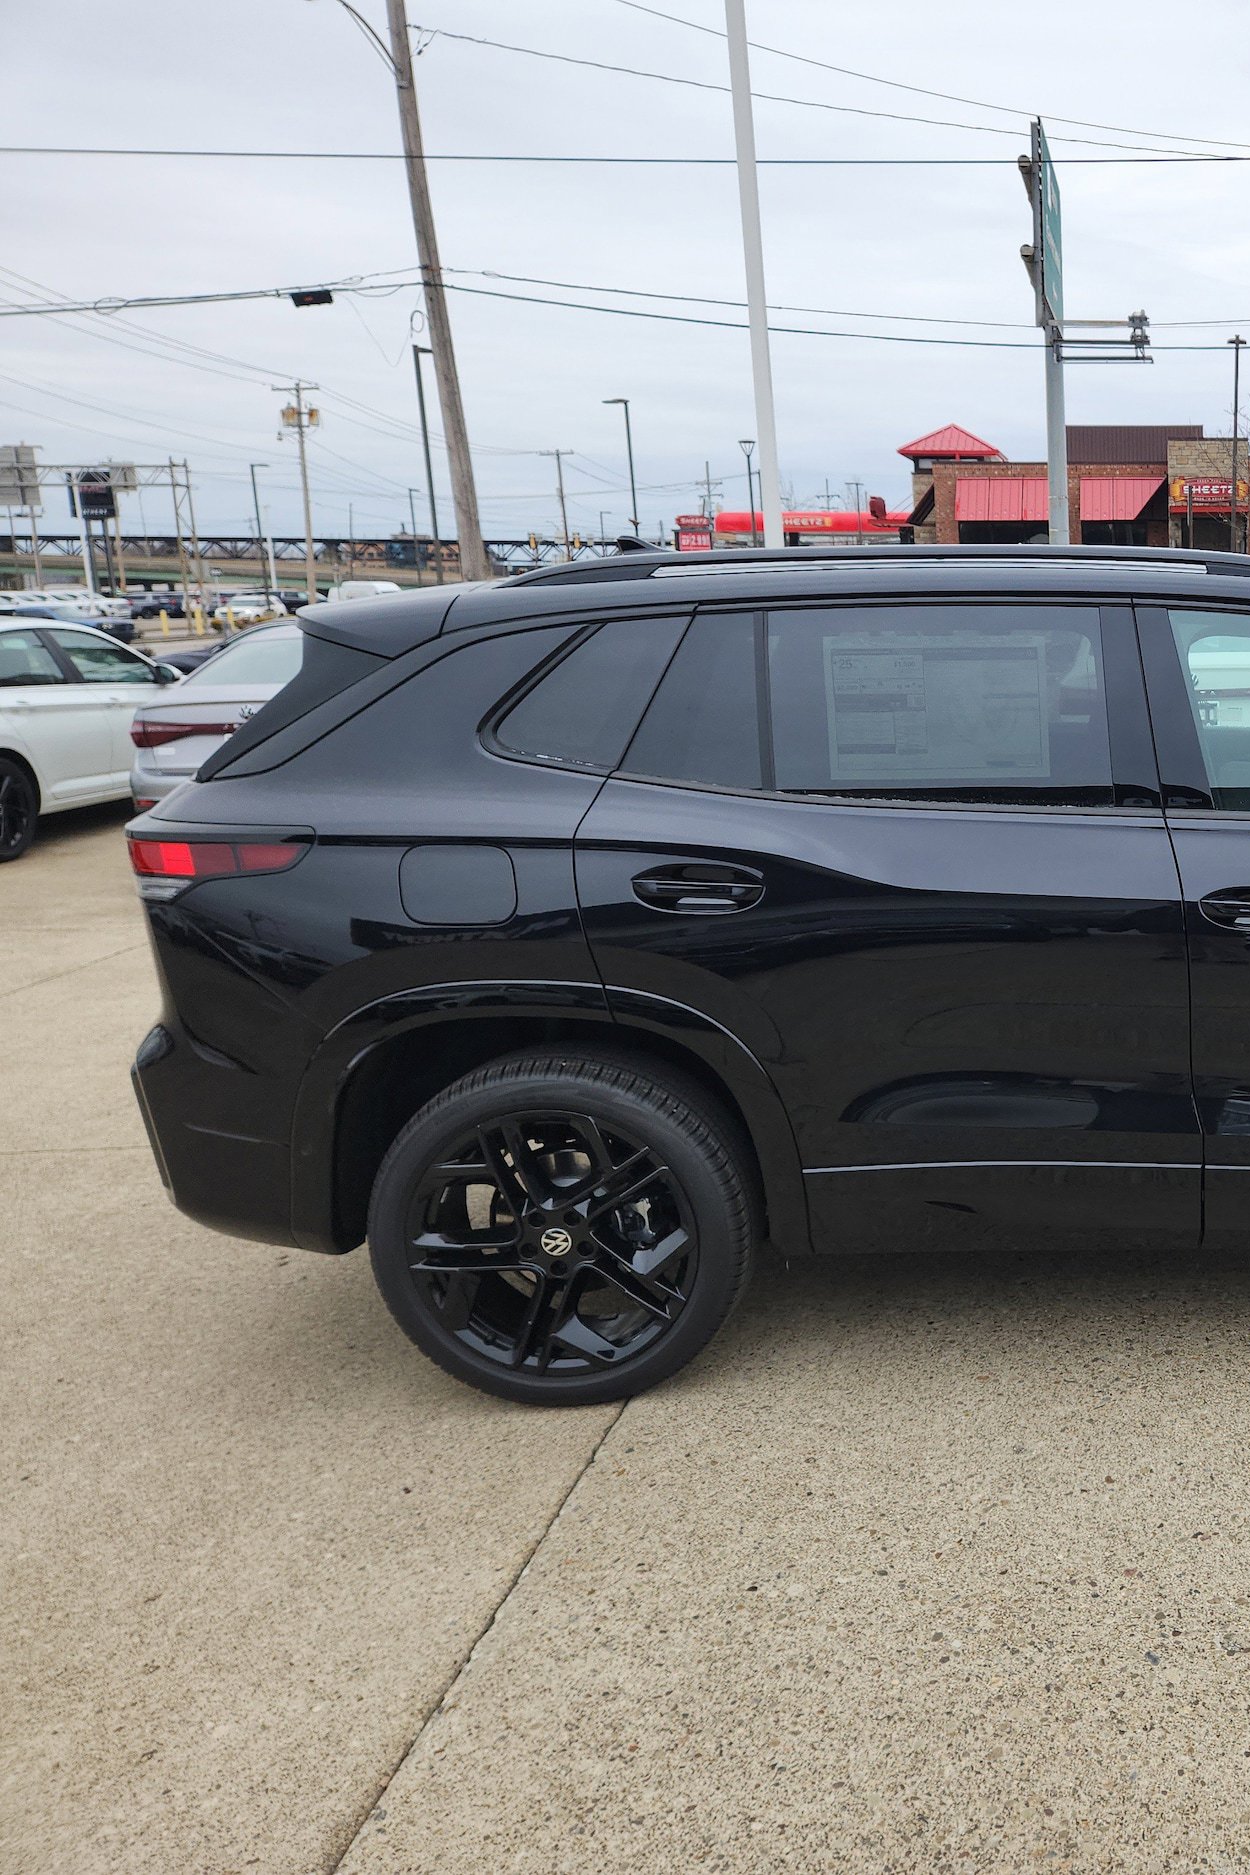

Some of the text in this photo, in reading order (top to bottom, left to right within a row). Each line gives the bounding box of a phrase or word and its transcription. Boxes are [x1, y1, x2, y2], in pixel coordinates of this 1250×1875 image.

[1183, 485, 1234, 494] SHEETZ
[679, 516, 708, 525] SHEETZ
[784, 516, 823, 526] HEETZ
